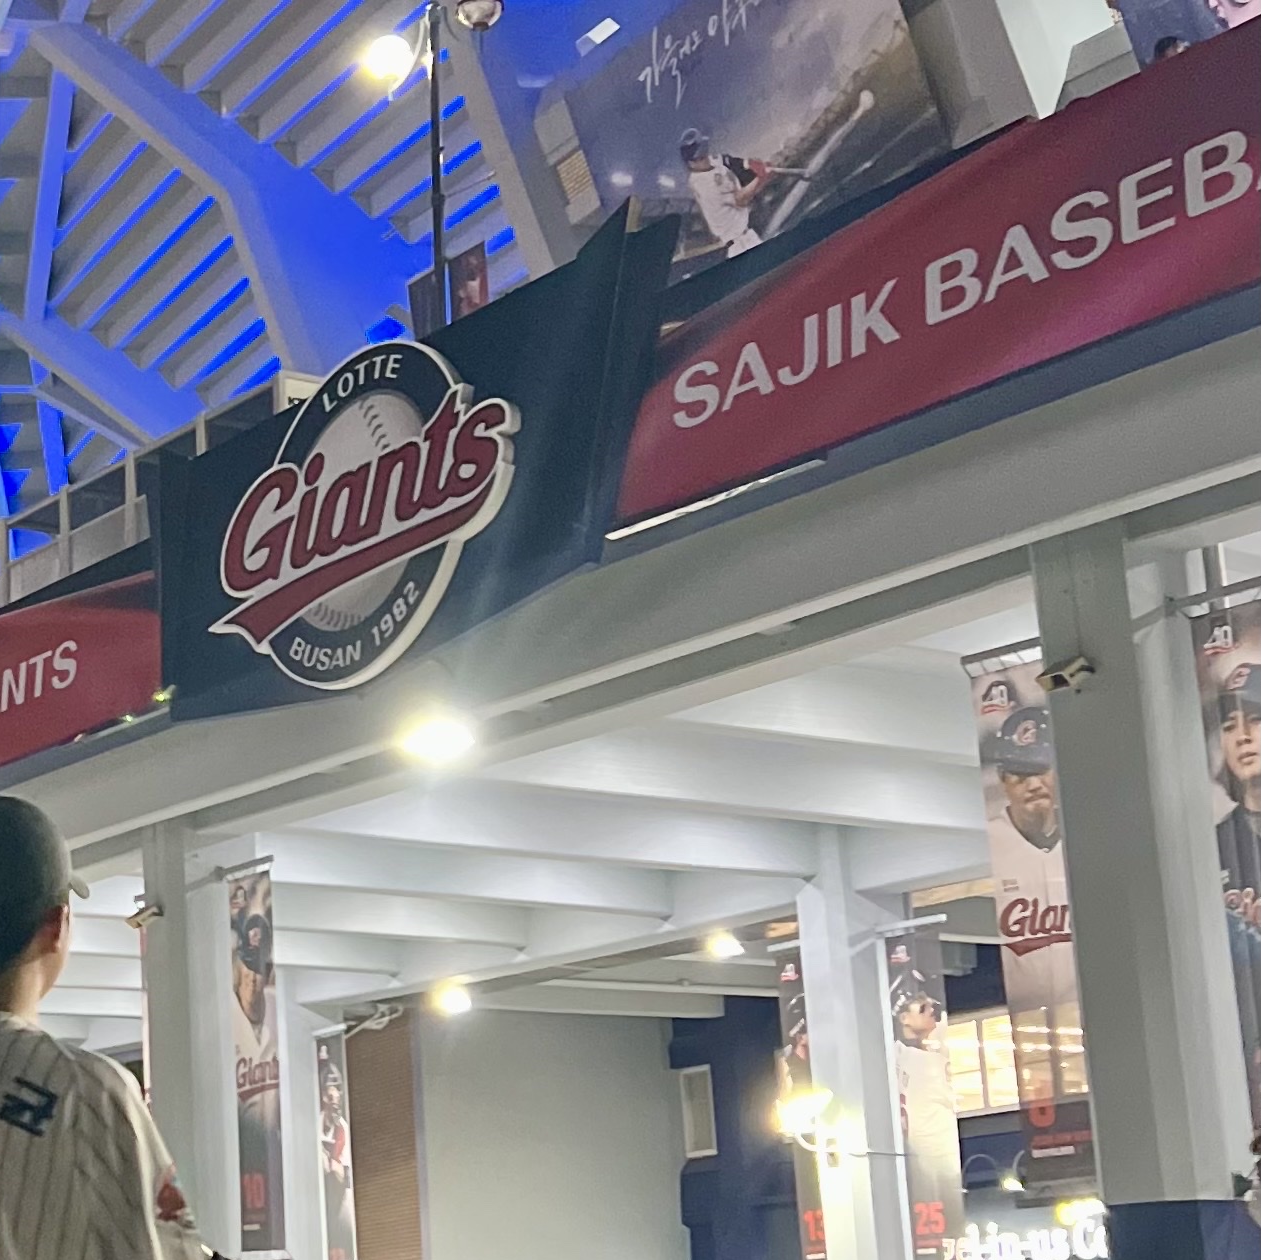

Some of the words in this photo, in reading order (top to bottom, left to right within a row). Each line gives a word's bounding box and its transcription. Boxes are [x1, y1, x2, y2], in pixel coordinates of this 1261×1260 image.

[672, 278, 901, 429] SAJIK
[925, 130, 1261, 326] BASEB
[321, 354, 404, 413] LOTTE
[223, 391, 508, 594] Giants
[289, 636, 363, 671] BUSAN
[370, 580, 421, 647] 1982
[915, 1202, 946, 1235] 25
